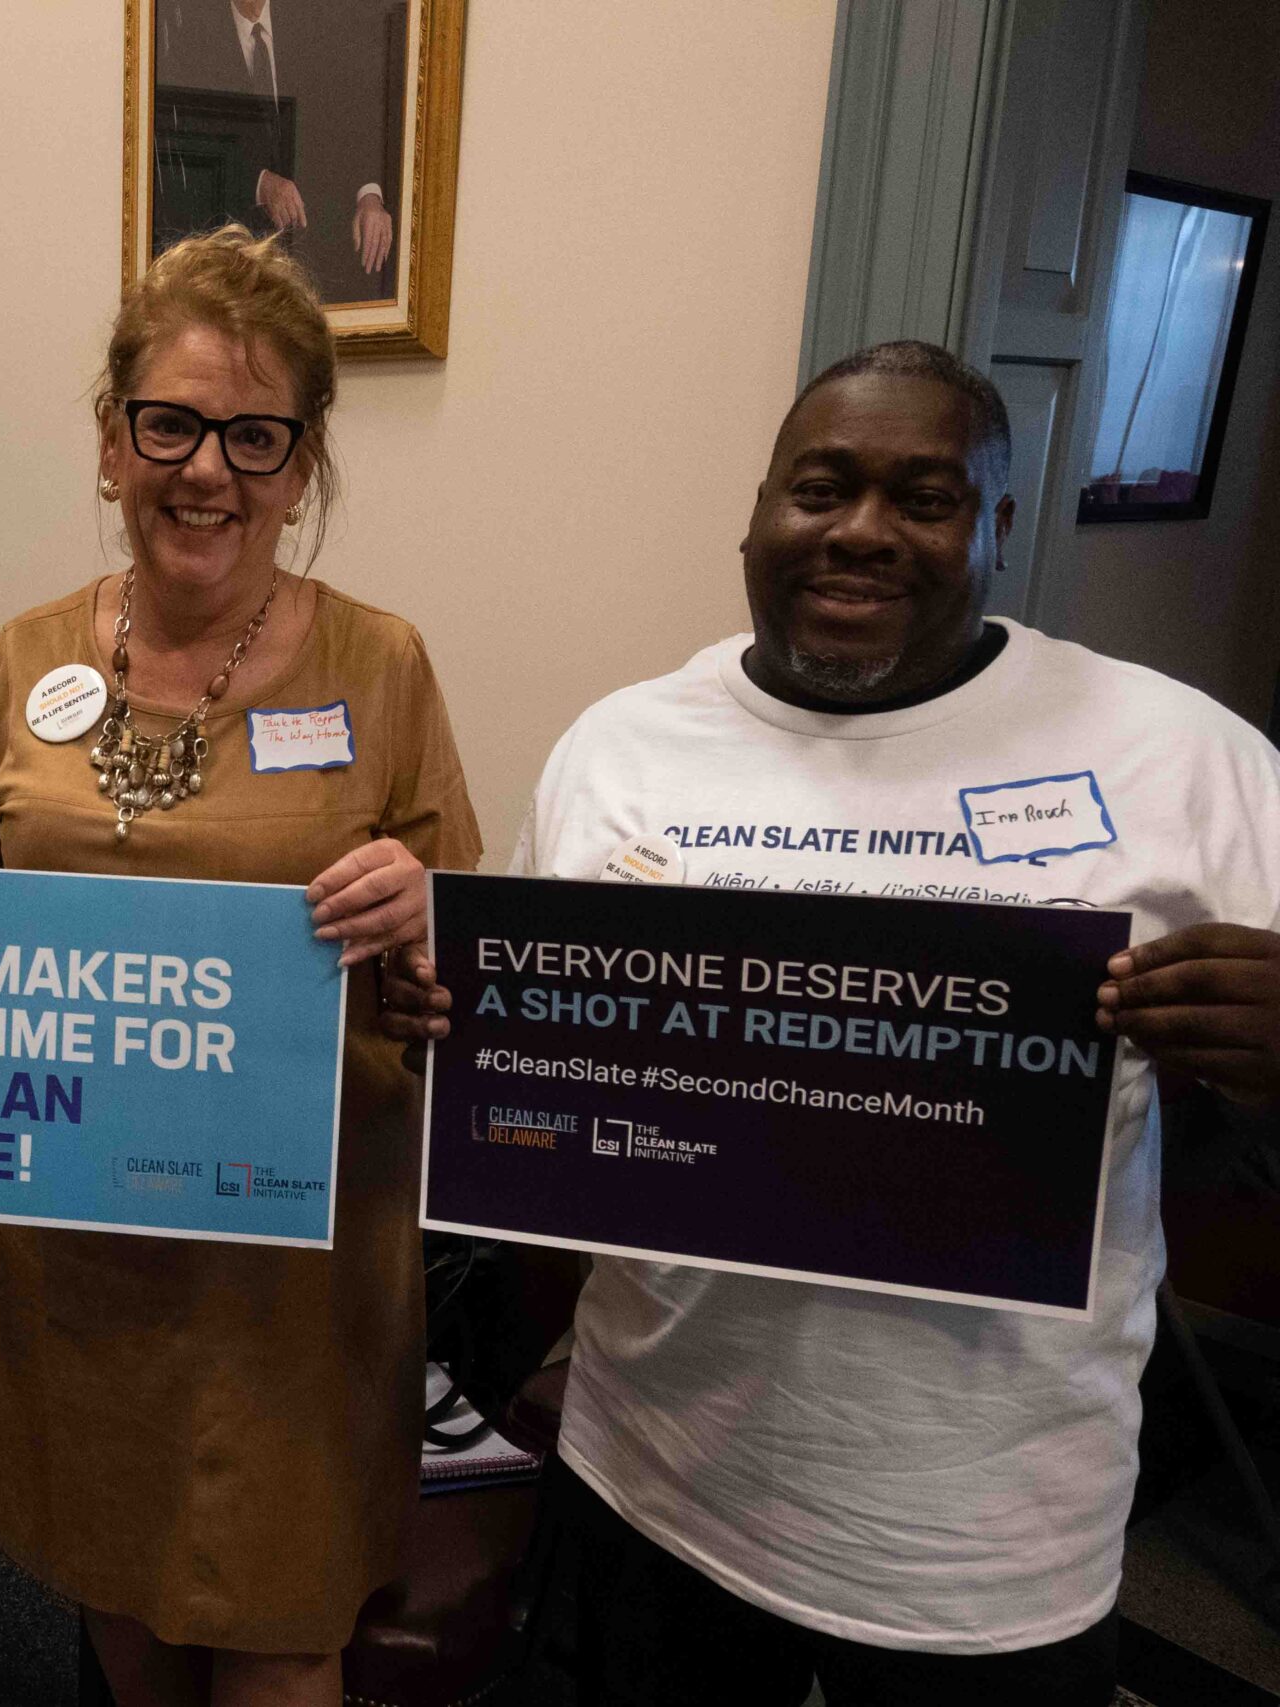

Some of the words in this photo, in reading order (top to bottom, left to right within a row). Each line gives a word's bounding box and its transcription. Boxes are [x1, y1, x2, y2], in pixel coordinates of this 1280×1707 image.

[48, 676, 77, 695] RECORD
[31, 716, 41, 726] BE
[48, 706, 64, 718] LIFE
[262, 729, 285, 742] The
[290, 729, 314, 745] Way
[317, 728, 348, 741] Home
[761, 825, 860, 853] SLATE
[634, 845, 641, 854] A
[641, 847, 668, 867] RECORD
[606, 862, 616, 872] BE
[614, 867, 621, 875] A
[648, 868, 665, 881] NOT
[477, 938, 725, 990] EVERYONE
[740, 957, 1011, 1016] DESERVES
[475, 984, 508, 1018] A
[520, 987, 650, 1031] SHOT
[661, 1001, 731, 1039] AT
[744, 1008, 1100, 1078] REDEMPTION
[114, 1016, 236, 1073] FOR
[475, 1048, 637, 1086] #CleanSlate
[640, 1066, 985, 1126] #SecondChanceMonth
[488, 1106, 533, 1127] CLEAN
[537, 1111, 579, 1132] SLATE
[488, 1126, 557, 1149] DELAWARE
[636, 1124, 660, 1136] THE
[598, 1139, 620, 1151] CSI
[635, 1136, 676, 1149] CLEAN
[678, 1141, 718, 1154] SLATE
[634, 1148, 696, 1164] INITIATIVE
[127, 1157, 165, 1174] CLEAN
[167, 1159, 203, 1177] SLATE
[254, 1166, 276, 1176] THE
[220, 1182, 240, 1192] CSI
[253, 1177, 289, 1188] CLEAN
[291, 1180, 326, 1191] SLATE
[253, 1189, 307, 1200] INITIATIVE
